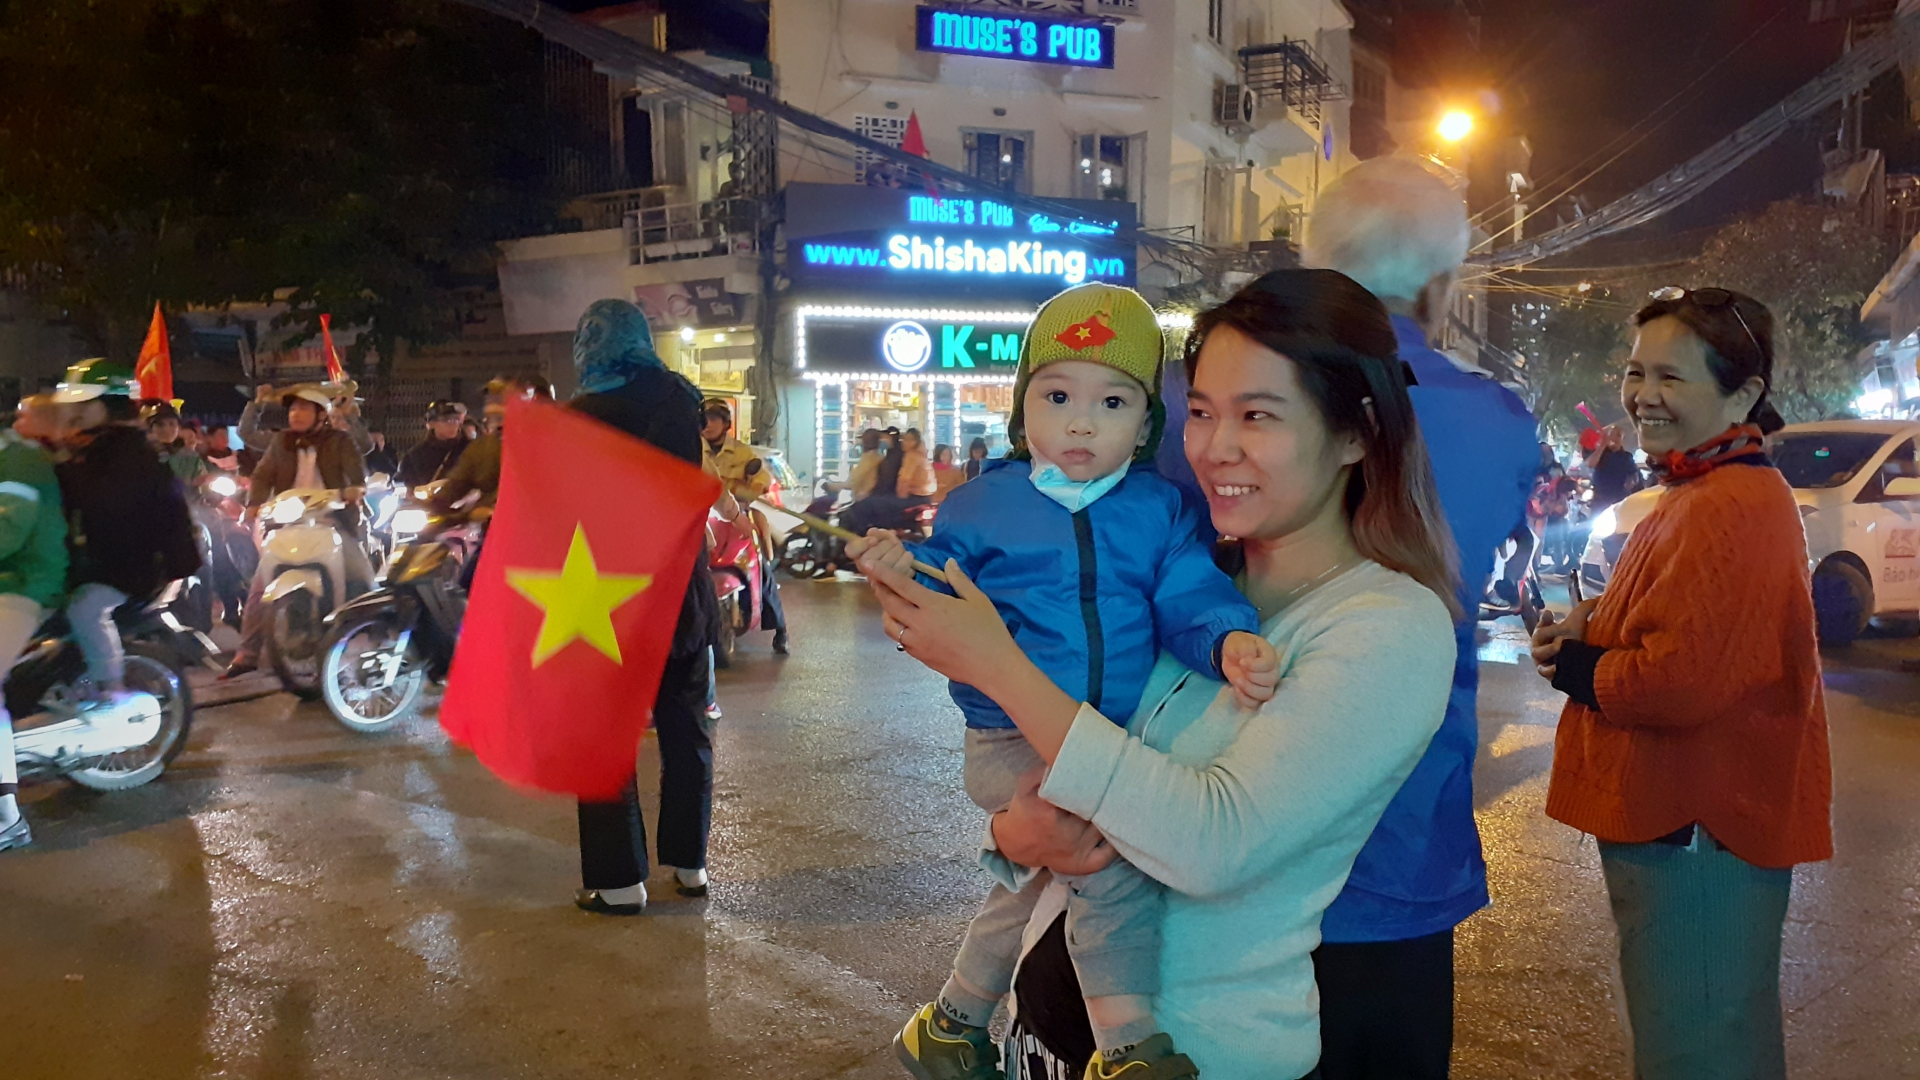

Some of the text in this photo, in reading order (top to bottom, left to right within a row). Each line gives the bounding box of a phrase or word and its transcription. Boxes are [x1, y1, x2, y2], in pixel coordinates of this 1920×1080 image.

[933, 11, 1101, 61] MUSE'S PUB
[909, 196, 975, 224] MUSE'S
[981, 200, 1014, 226] PUB
[804, 235, 1125, 283] www.ShishaKing.vn
[942, 324, 1019, 368] K-M
